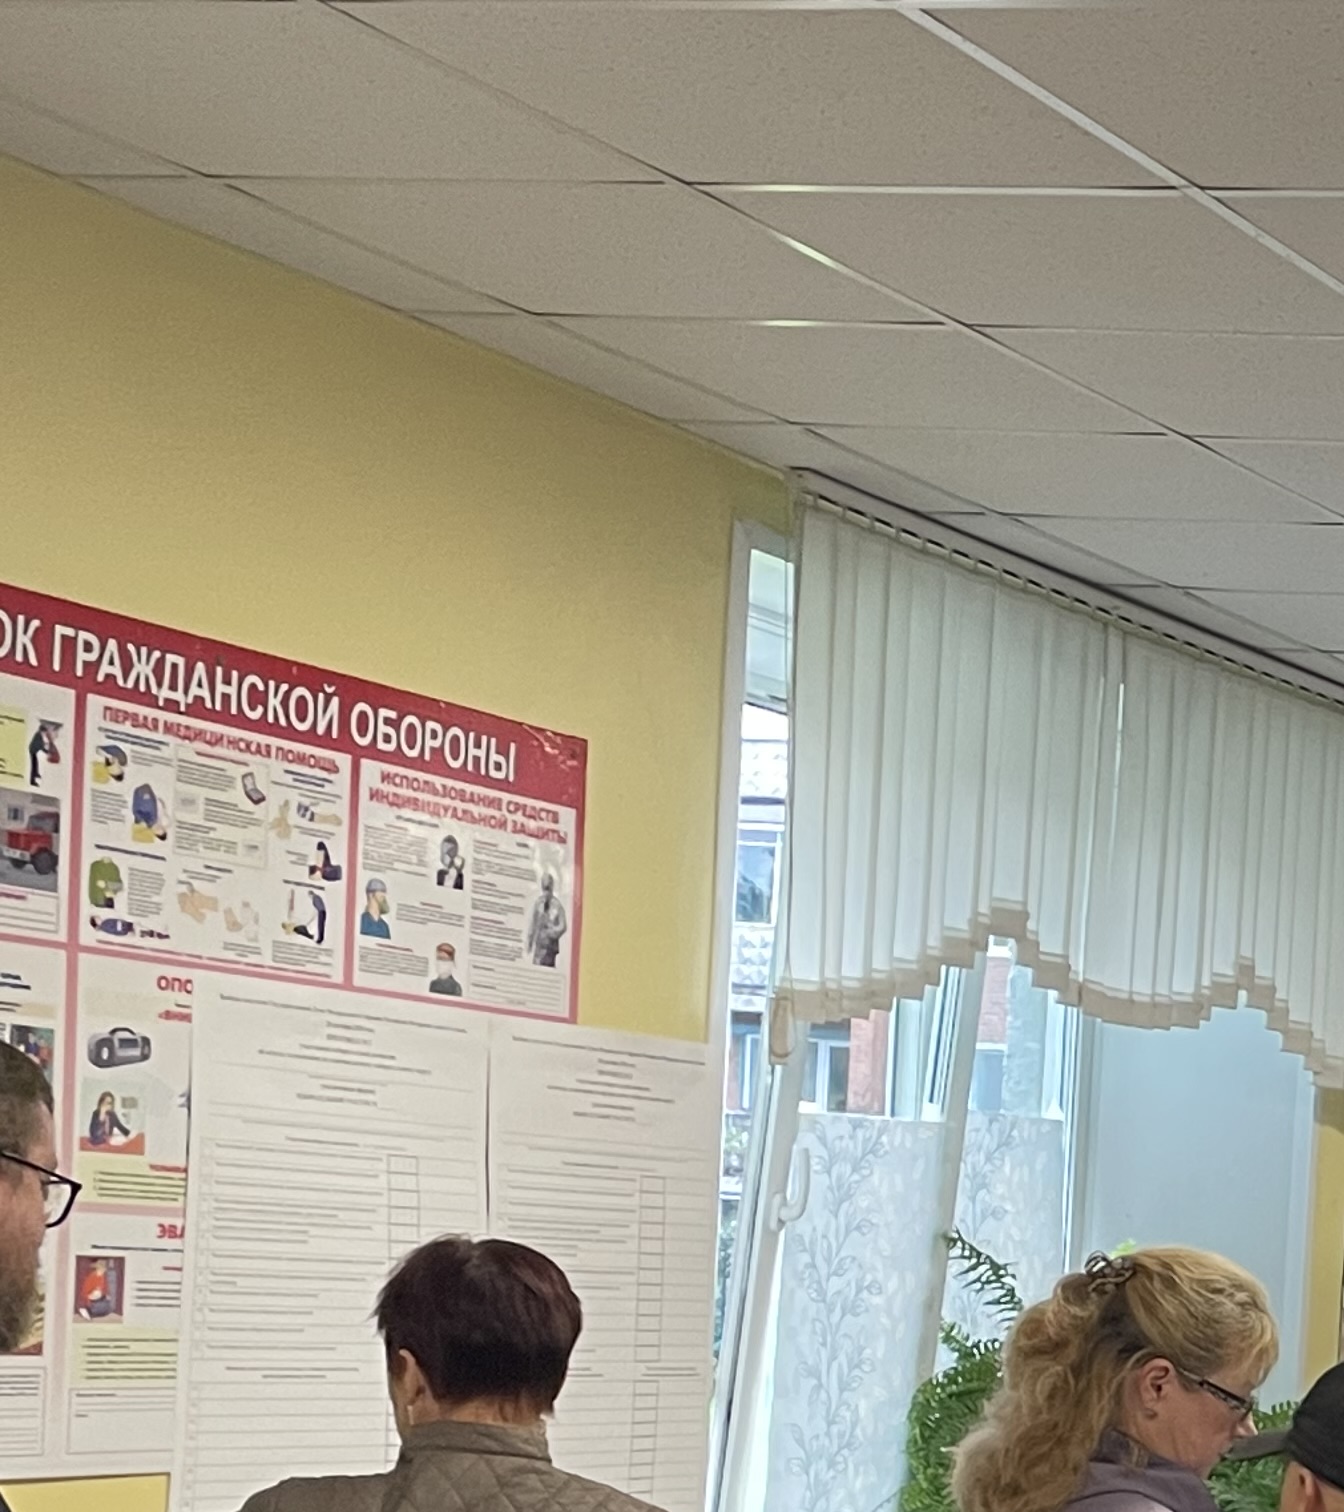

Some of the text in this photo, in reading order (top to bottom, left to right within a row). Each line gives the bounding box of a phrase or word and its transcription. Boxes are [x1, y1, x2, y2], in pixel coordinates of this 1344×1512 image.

[52, 624, 340, 739] ГРАЖДАНСКОЙ
[350, 702, 516, 782] ОБОРОНЫ
[103, 706, 340, 774] ПЕРВАЯ МЕДИЦИНСКАЯ ПОМОЩЬ
[368, 786, 567, 844] ИНДИВИДУАЛЬНОЙ ЗАЩИТЫ
[380, 770, 560, 824] ИСПОЛЬЗОВАНИЕ СРЕДСТВ
